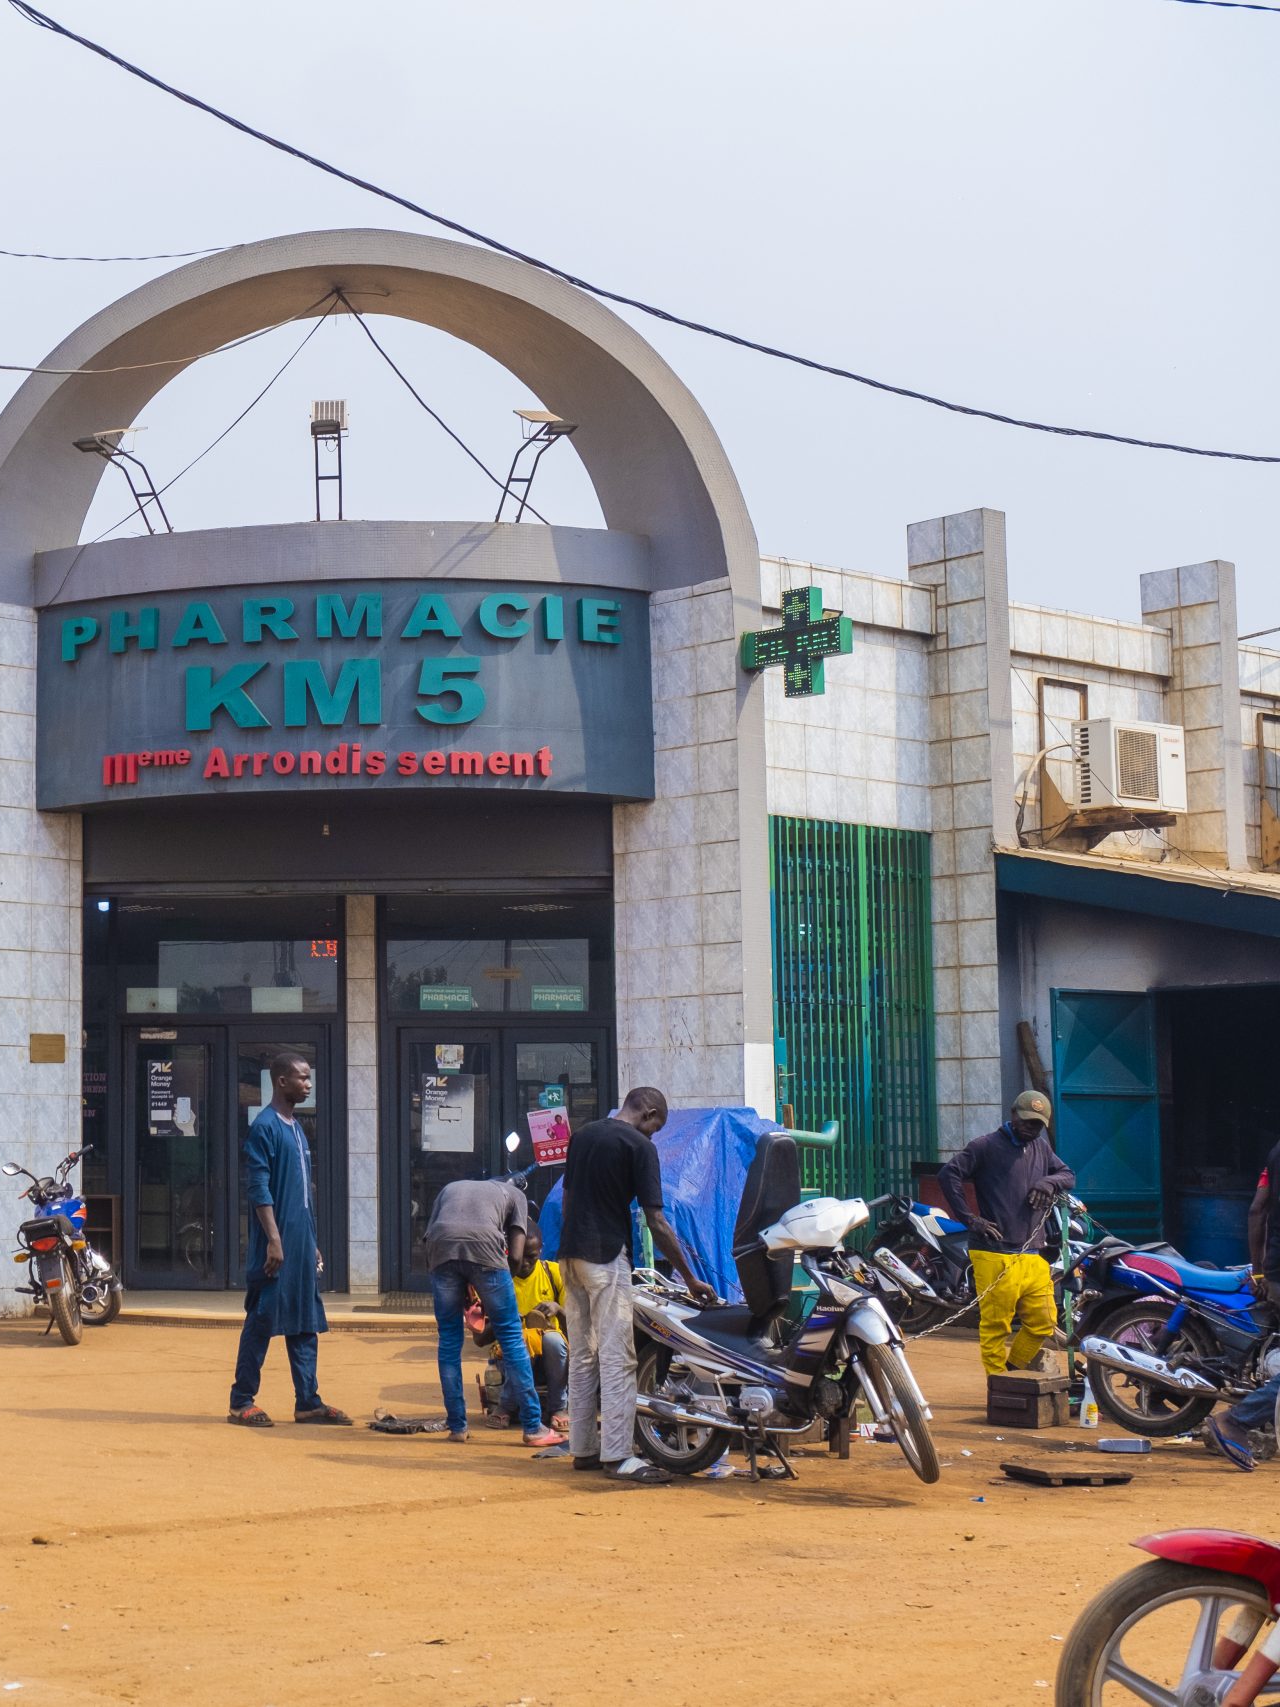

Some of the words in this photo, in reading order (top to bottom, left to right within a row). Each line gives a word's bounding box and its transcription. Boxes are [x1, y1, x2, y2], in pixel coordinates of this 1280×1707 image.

[61, 591, 622, 662] PHARMACIE
[422, 993, 470, 1002] PHARMACIE
[533, 993, 582, 1002] PHARMACIE
[425, 1089, 448, 1097] Orange
[425, 1095, 446, 1103] Money
